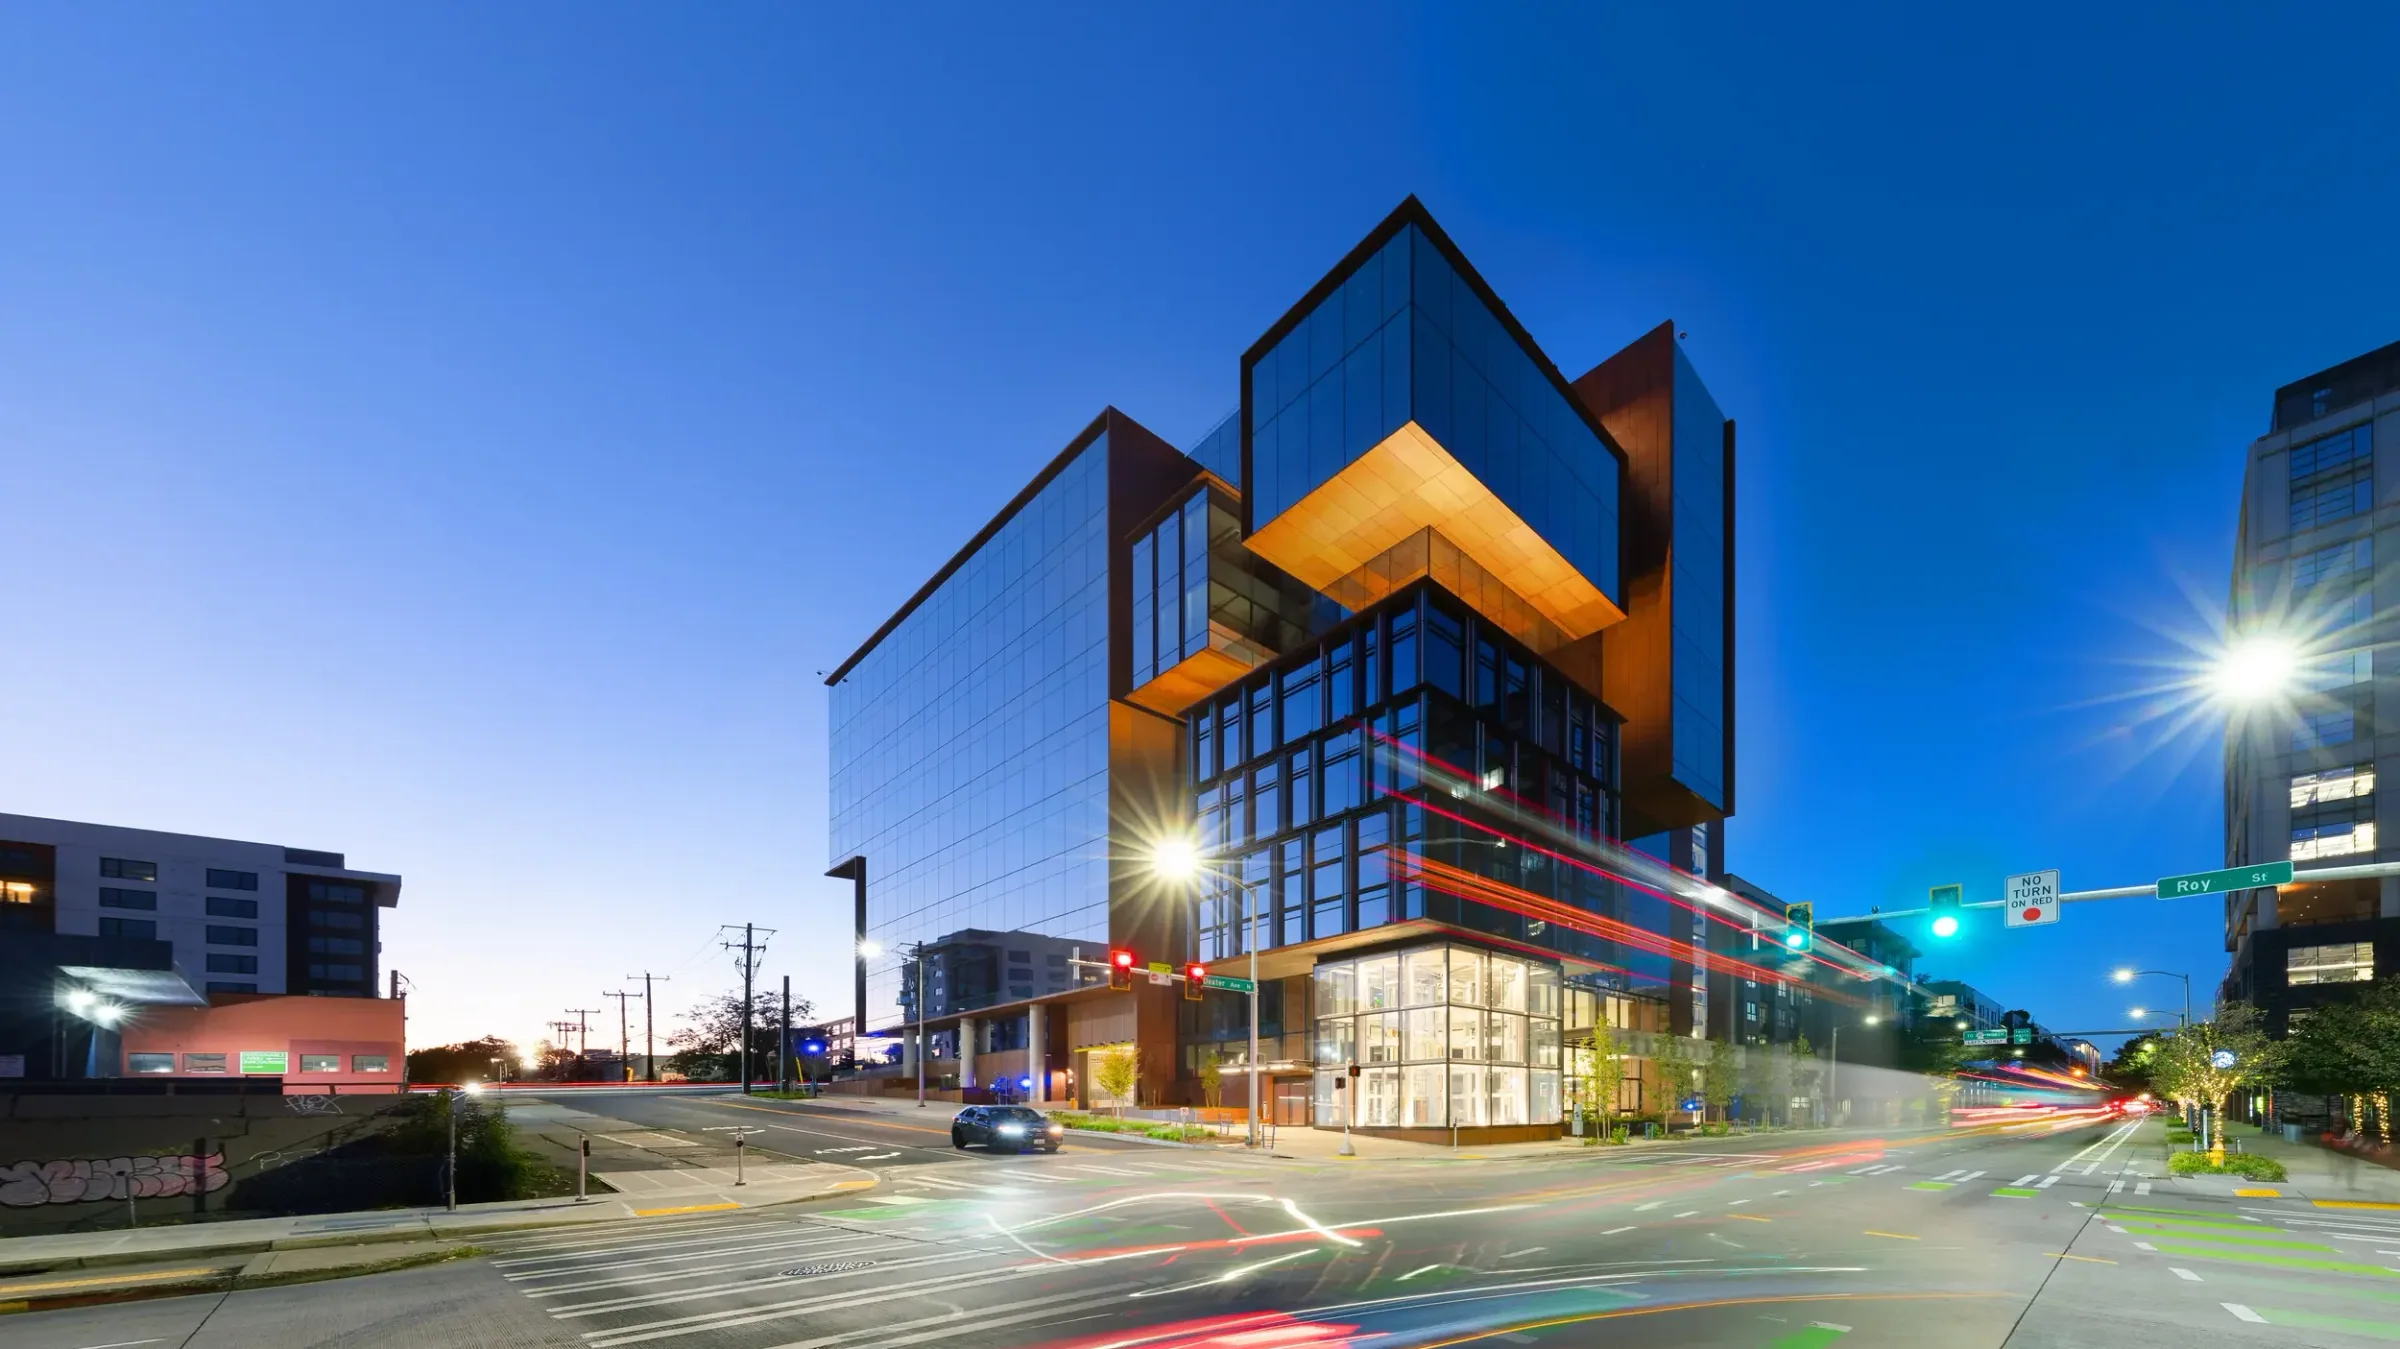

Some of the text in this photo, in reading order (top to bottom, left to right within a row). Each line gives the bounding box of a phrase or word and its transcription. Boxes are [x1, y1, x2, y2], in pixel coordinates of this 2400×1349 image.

[2022, 875, 2042, 887] NO
[2176, 872, 2269, 893] Roy St
[2012, 885, 2052, 899] TURN
[2011, 896, 2053, 909] ON RED
[1230, 980, 1241, 989] Ave
